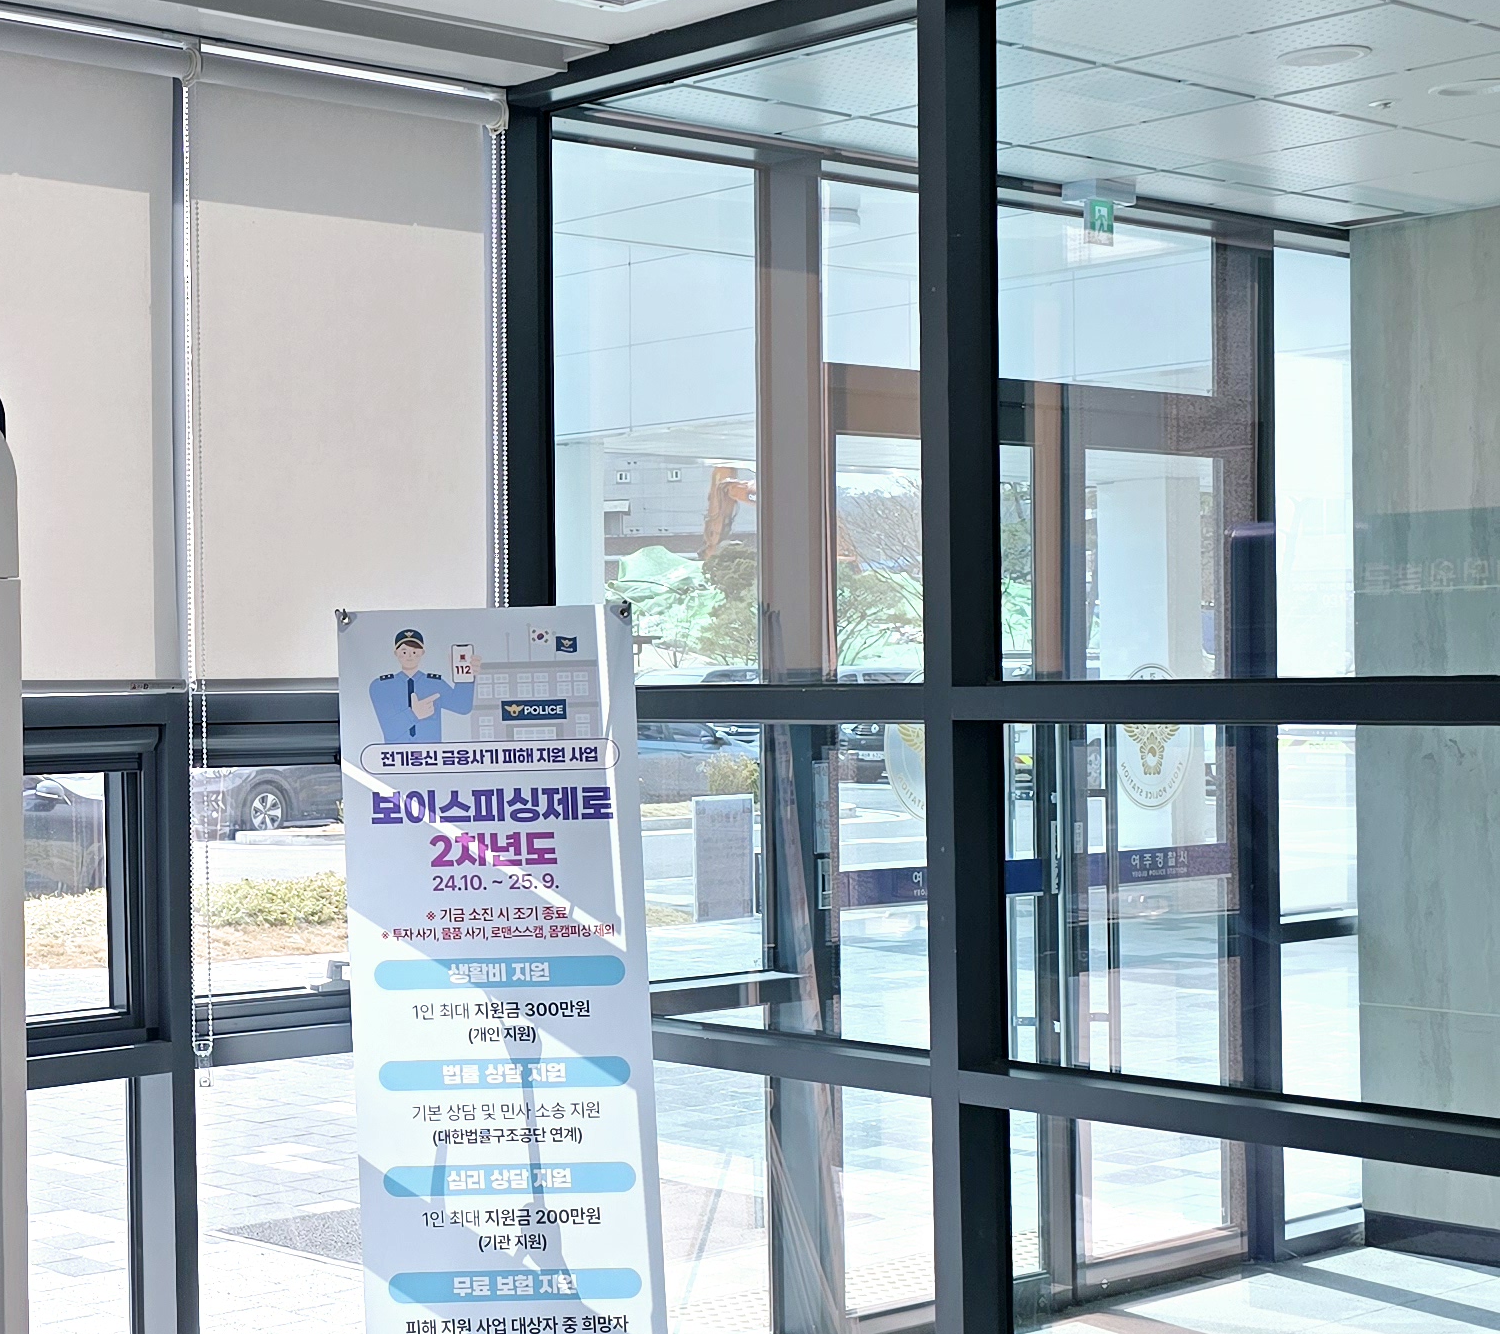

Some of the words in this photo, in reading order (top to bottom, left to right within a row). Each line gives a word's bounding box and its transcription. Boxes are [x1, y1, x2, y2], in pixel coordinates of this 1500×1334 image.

[455, 665, 471, 675] 112
[524, 704, 563, 715] POLICE
[381, 750, 438, 767] 전기통신
[441, 749, 499, 766] 금융사기
[502, 748, 534, 764] 피해
[537, 747, 566, 763] 지원
[569, 746, 598, 762] 사업
[371, 786, 614, 825] 보이스피싱제로
[429, 831, 558, 868] 2차년도
[432, 874, 487, 892] 24.10.
[440, 907, 465, 922] 기금
[468, 907, 493, 922] 소진
[498, 907, 510, 921] 시
[513, 906, 538, 921] 조기
[542, 905, 568, 920] 종료
[392, 927, 414, 942] 투자
[415, 927, 440, 943] 사기,
[442, 927, 462, 941] 물품
[464, 926, 489, 942] 사기,
[491, 926, 547, 941] 로맨스스캠,
[549, 924, 591, 939] 몸캠피싱
[448, 963, 507, 984] 생활비
[512, 963, 550, 982] 지원
[412, 1002, 434, 1020] 1인
[439, 1002, 469, 1019] 최대
[474, 1001, 521, 1019] 지원금
[524, 999, 590, 1018] 300만원
[468, 1027, 500, 1044] (개인
[503, 1026, 537, 1042] 지원)
[442, 1064, 480, 1085] 법률
[485, 1063, 523, 1084] 상담
[527, 1062, 566, 1083] 지원
[412, 1105, 442, 1123] 기본
[447, 1103, 476, 1121] 상담
[482, 1102, 497, 1120] 및
[500, 1102, 532, 1120] 민사
[535, 1102, 566, 1119] 소송
[570, 1101, 601, 1119] 지원
[432, 1127, 547, 1147] (대한법률구조공단
[550, 1126, 583, 1144] 연계)
[447, 1170, 486, 1190] 심리
[491, 1168, 528, 1189] 상담
[533, 1168, 572, 1188] 지원
[422, 1210, 445, 1228] 1인
[450, 1210, 480, 1227] 최대
[485, 1208, 532, 1226] 지원금
[535, 1207, 601, 1225] 200만원
[478, 1234, 511, 1252] (기관
[515, 1233, 547, 1251] 지원)
[453, 1276, 492, 1297] 무료
[496, 1275, 533, 1296] 보험
[538, 1274, 578, 1295] 지원
[511, 1316, 558, 1334] 대상자
[562, 1316, 577, 1333] 중
[582, 1314, 629, 1333] 희망자
